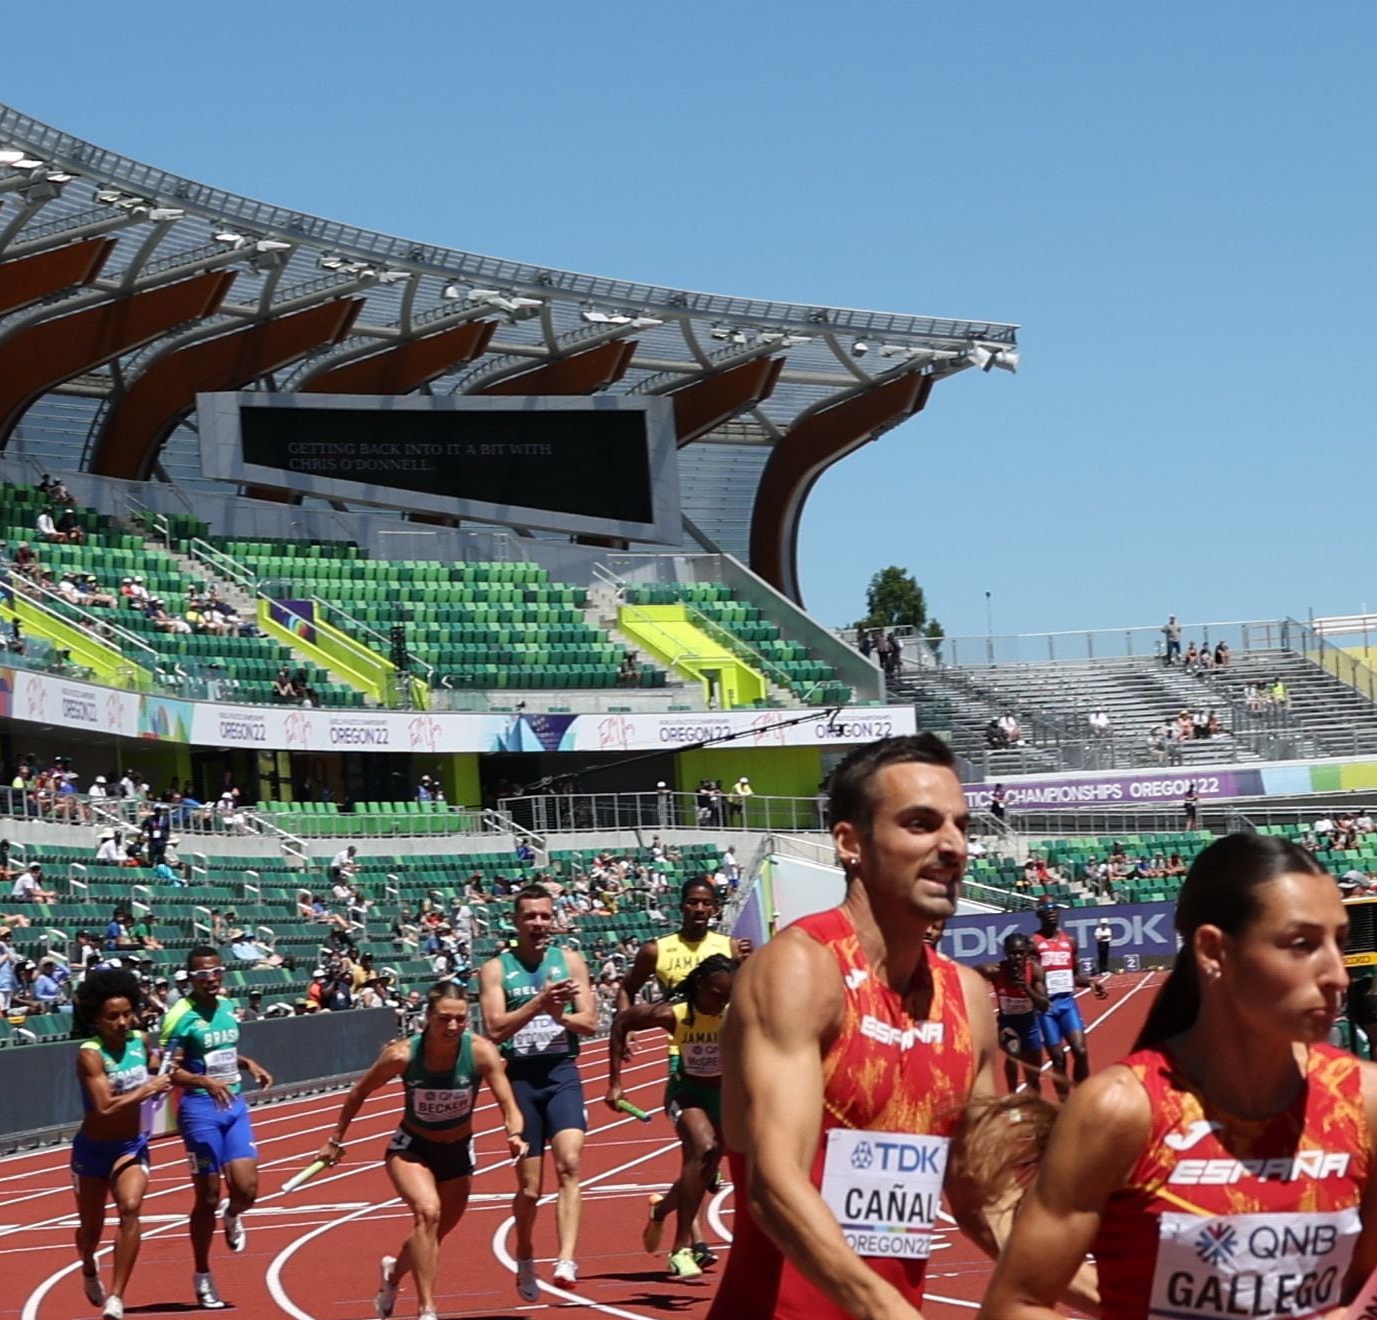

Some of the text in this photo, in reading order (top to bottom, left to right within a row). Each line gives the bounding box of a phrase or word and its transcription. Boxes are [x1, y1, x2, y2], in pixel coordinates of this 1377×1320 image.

[288, 442, 553, 455] GETTING BACK INTO IT A BIT WITH
[289, 458, 336, 470] CHRIS
[1004, 784, 1122, 806] CHAMPIONSHIPS
[1065, 914, 1168, 949] TDK
[667, 957, 706, 971] JAMA
[508, 986, 539, 997] IREL
[682, 1032, 718, 1044] JAMAI
[687, 1056, 718, 1066] McGRE
[418, 1100, 468, 1115] BECKER
[875, 1142, 939, 1174] TDK
[1168, 1149, 1349, 1185] ESPAÑA
[844, 1184, 937, 1224] CAÑAL
[1249, 1224, 1338, 1260] QNB
[1167, 1266, 1338, 1316] GALLEGO
